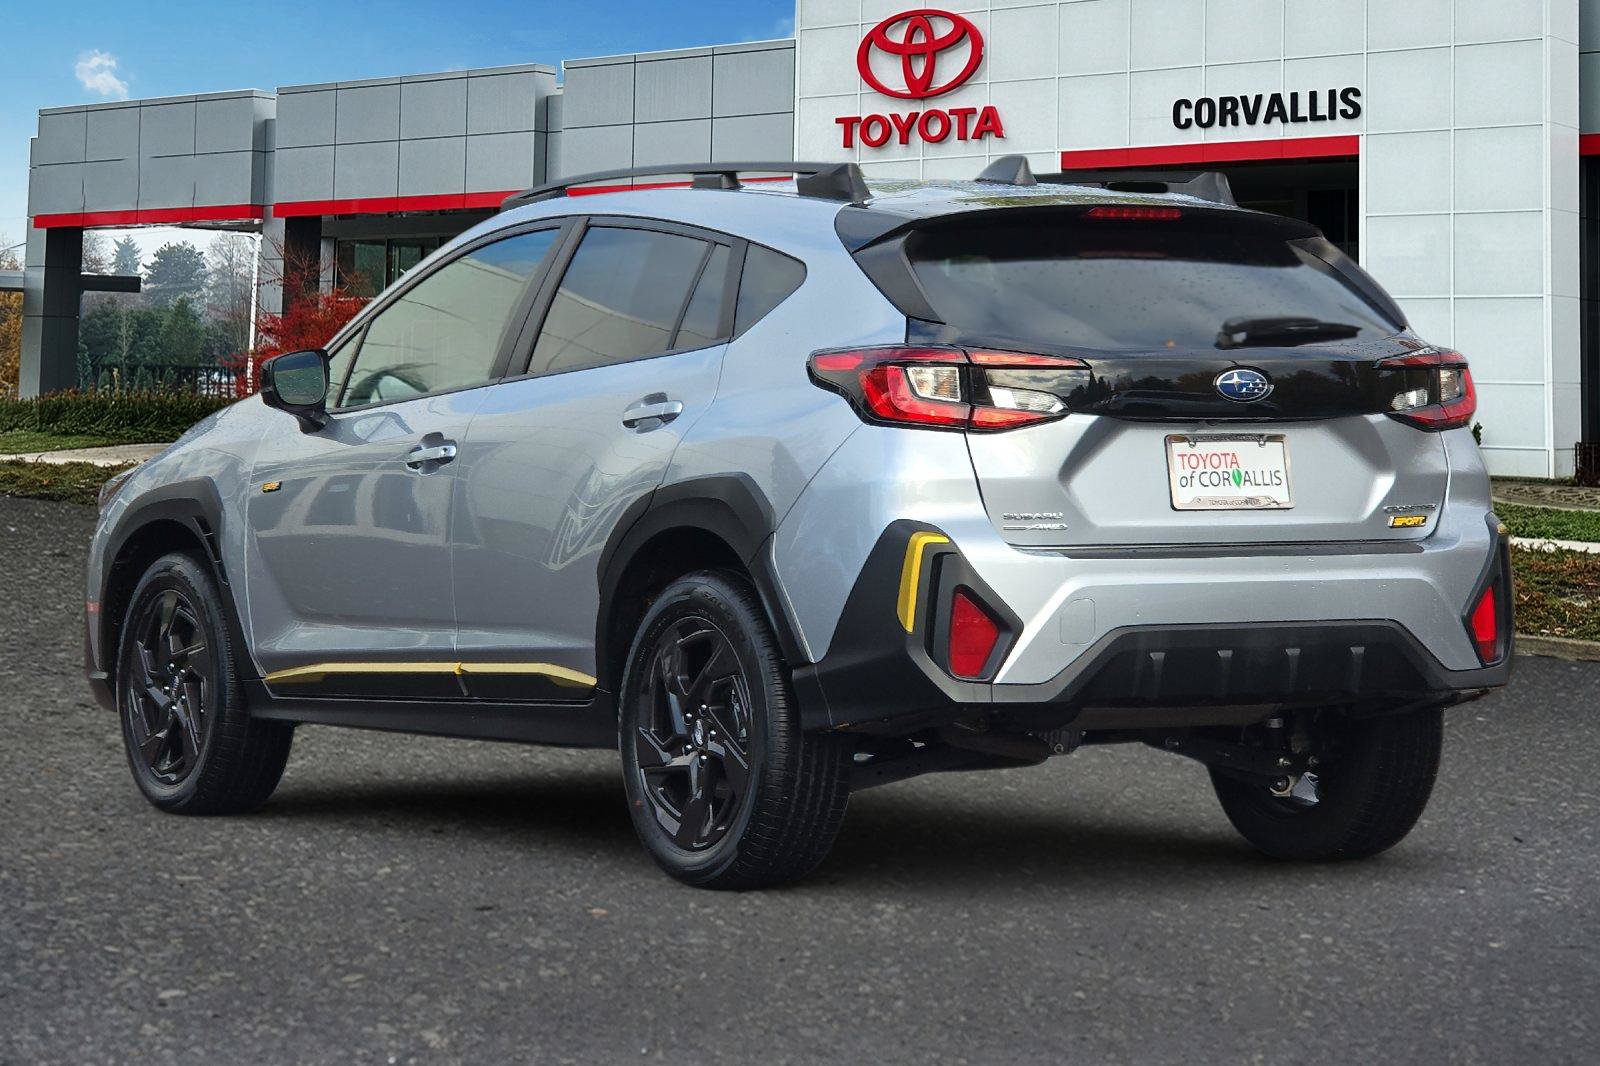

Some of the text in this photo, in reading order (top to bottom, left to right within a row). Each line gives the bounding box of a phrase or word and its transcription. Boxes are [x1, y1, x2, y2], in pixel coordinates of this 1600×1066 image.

[1172, 87, 1362, 130] CORVALLIS
[835, 105, 1005, 148] TOYOTA
[1177, 452, 1240, 470] TOYOTA
[1180, 471, 1196, 487] of
[1002, 511, 1063, 520] SUBARU
[1392, 516, 1426, 526] SPORT
